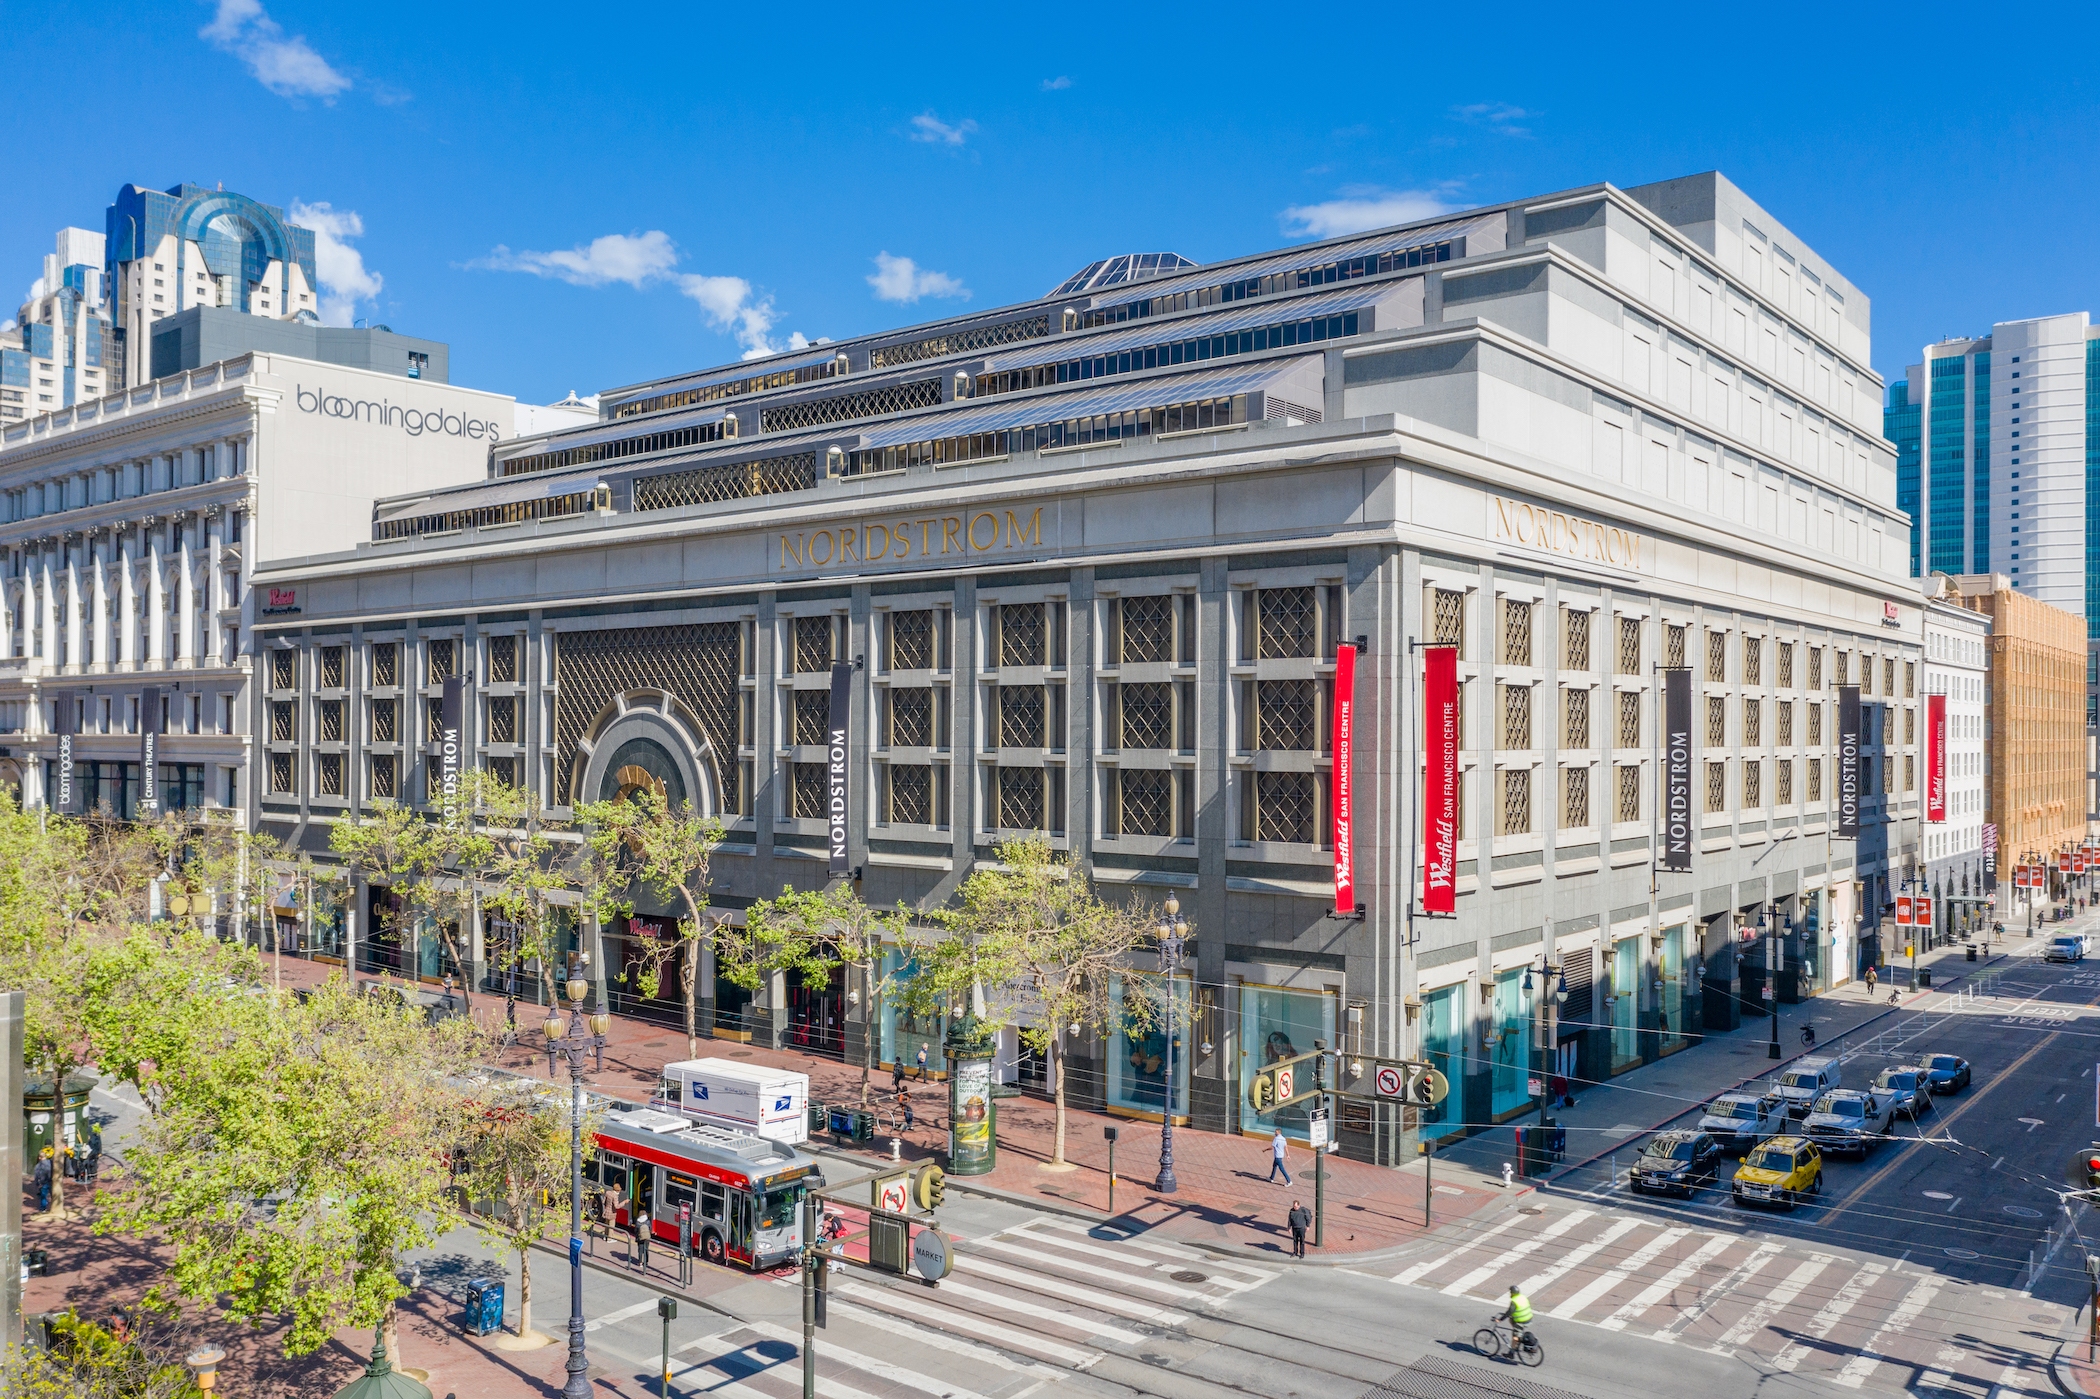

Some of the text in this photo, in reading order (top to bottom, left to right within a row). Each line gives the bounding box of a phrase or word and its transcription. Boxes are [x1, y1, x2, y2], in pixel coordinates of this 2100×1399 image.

[297, 384, 499, 442] bloomingdale's
[780, 507, 1043, 568] NORDSTROM
[1495, 497, 1640, 569] NORDSTROM
[1341, 701, 1349, 738] CENTRE
[145, 767, 153, 798] CENTURY
[831, 729, 845, 857] NORDSTROM
[1340, 741, 1348, 795] FRANCISCO
[1670, 732, 1687, 853] NORDSTROM
[1842, 733, 1856, 825] NORDSTROM
[1929, 776, 1944, 811] Westfield
[1429, 702, 1453, 891] Westfield SAN FRANCISCO CENTRE
[1336, 818, 1350, 891] Westfield
[1986, 847, 1995, 872] zetta
[2001, 1016, 2065, 1027] CLEAR
[2023, 1007, 2073, 1017] KEEP
[915, 1247, 943, 1263] MARKET
